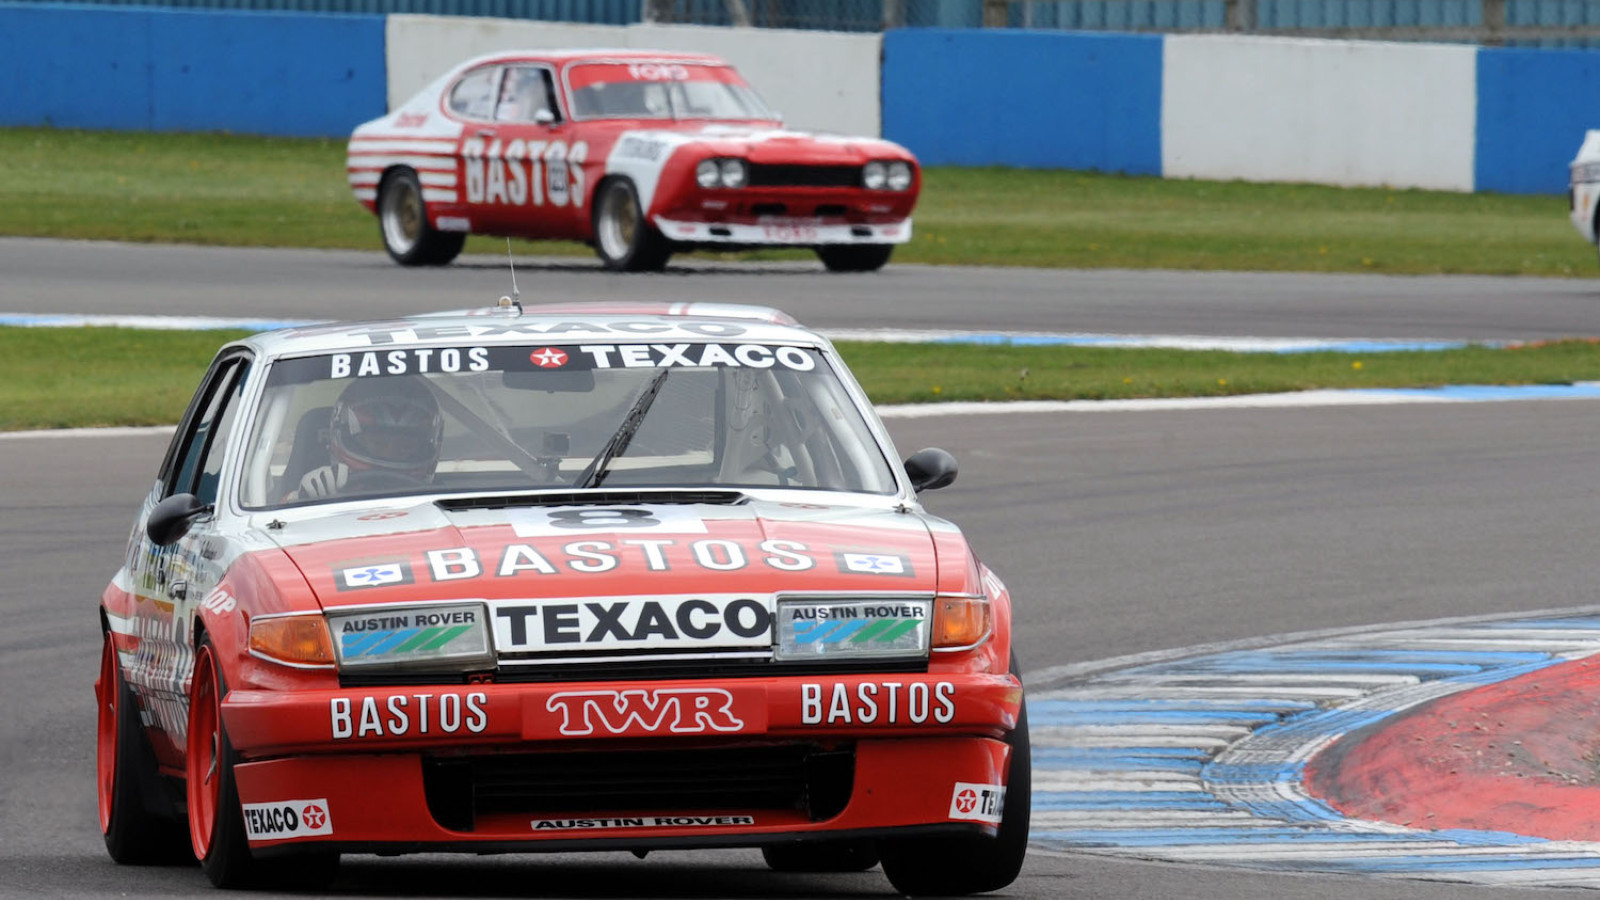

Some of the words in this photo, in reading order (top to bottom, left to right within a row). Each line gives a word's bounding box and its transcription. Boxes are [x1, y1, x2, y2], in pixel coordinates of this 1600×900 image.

[462, 138, 588, 207] BASTOS
[347, 320, 748, 345] TEXACO
[331, 347, 489, 379] BASTOS
[580, 344, 815, 371] TEXACO
[547, 508, 661, 529] 8
[426, 538, 815, 582] BASTOS
[342, 616, 408, 633] AUSTIN
[415, 611, 475, 627] ROVER
[496, 598, 770, 646] TEXACO
[792, 606, 857, 620] AUSTIN
[865, 606, 924, 618] ROVER
[331, 692, 488, 739] BASTOS
[546, 688, 744, 736] TWR
[801, 682, 955, 725] BASTOS
[244, 806, 299, 834] TEXACO
[535, 818, 645, 829] AUSTIN
[655, 816, 752, 826] ROVER
